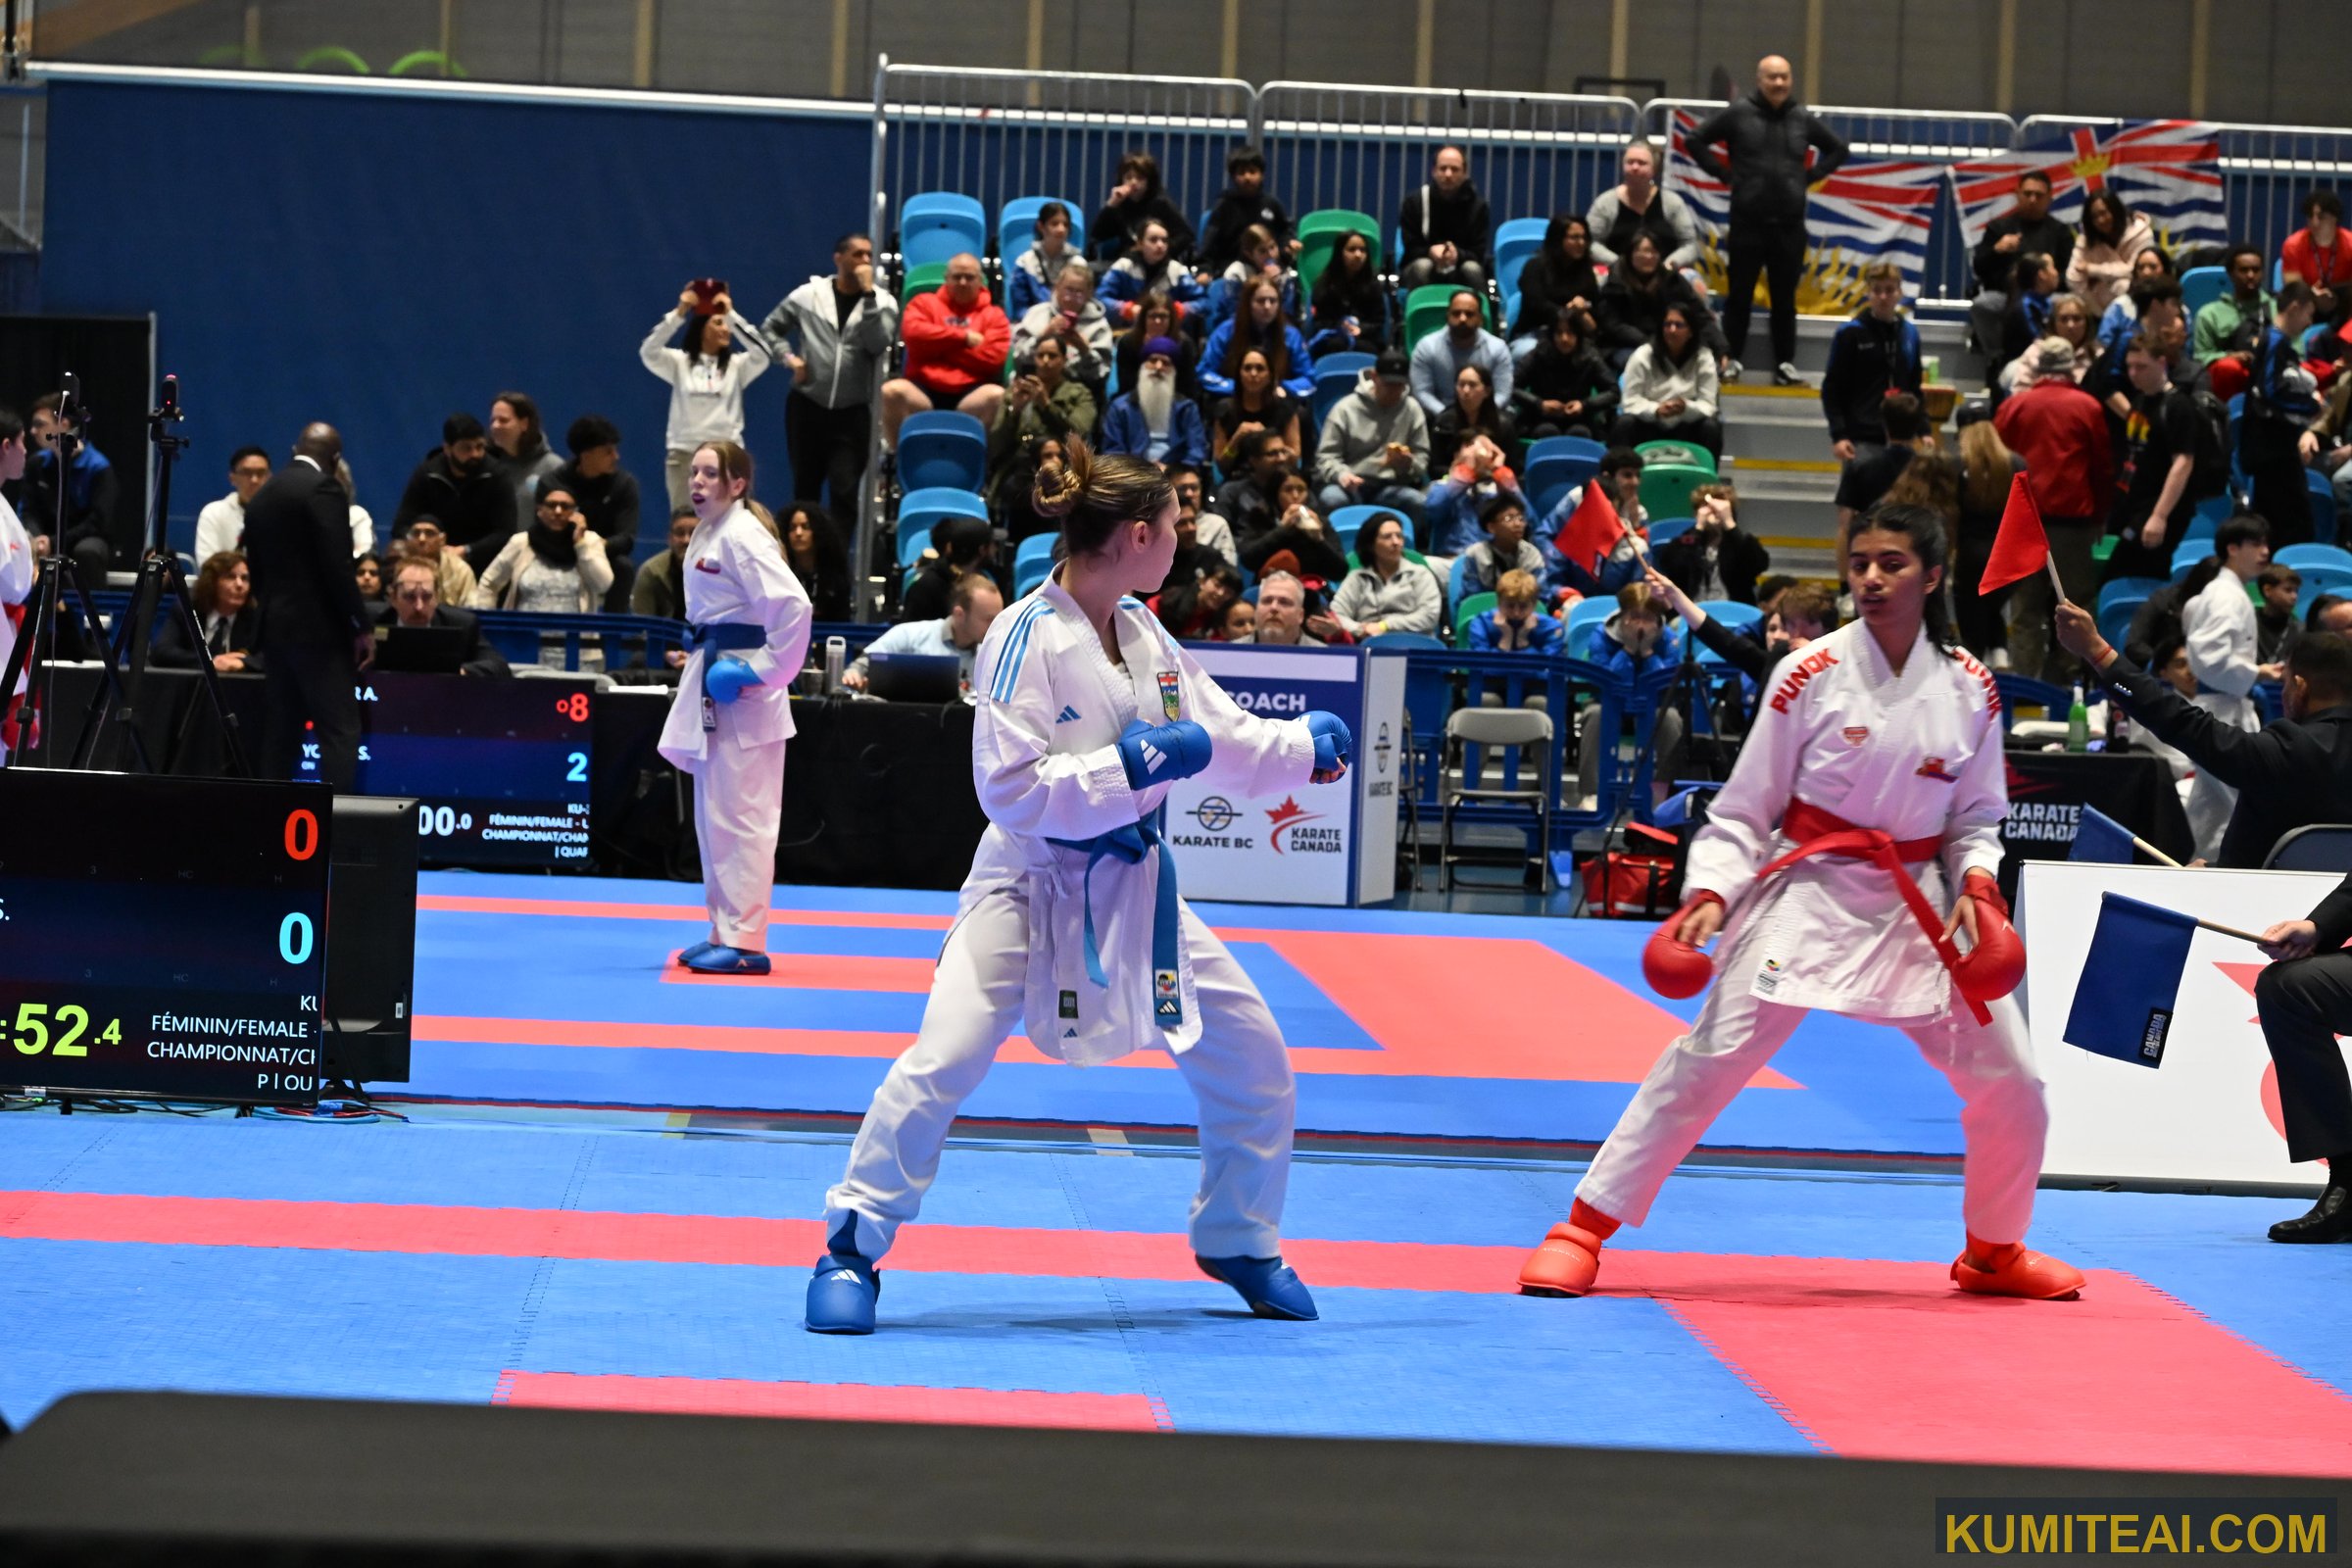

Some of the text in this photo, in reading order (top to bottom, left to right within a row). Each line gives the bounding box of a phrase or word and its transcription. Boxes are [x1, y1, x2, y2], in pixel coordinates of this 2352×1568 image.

[1770, 648, 1839, 714] PUNOK
[566, 752, 588, 782] 2
[2006, 802, 2081, 823] KARATE
[284, 808, 318, 860] 0
[1172, 835, 1253, 849] KARATE BC
[1291, 827, 1341, 841] KARATE
[2004, 820, 2079, 842] CANADA
[1291, 840, 1342, 853] CANADA
[278, 911, 314, 964] 0
[151, 1011, 309, 1039] FÉMININ/FEMALE
[2143, 1013, 2166, 1056] CANADA
[258, 1073, 269, 1089] P
[284, 1074, 313, 1092] OU
